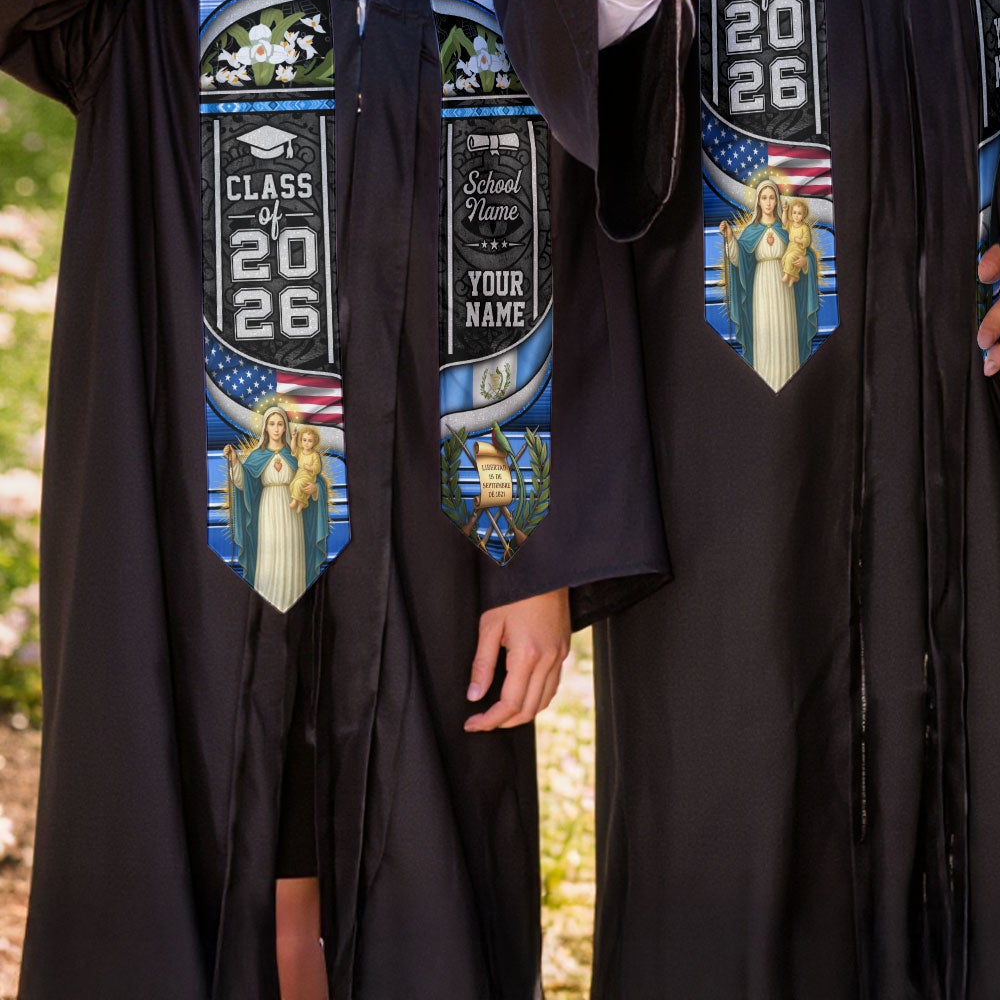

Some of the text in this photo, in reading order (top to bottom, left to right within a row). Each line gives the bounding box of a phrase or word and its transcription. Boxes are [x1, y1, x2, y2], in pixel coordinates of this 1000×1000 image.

[727, 56, 808, 116] 26
[226, 173, 313, 201] CLASS
[463, 169, 523, 195] School
[258, 200, 283, 241] of
[465, 197, 520, 222] Name
[229, 226, 318, 282] 20
[467, 270, 524, 297] YOUR
[232, 285, 320, 341] 26
[465, 301, 526, 328] NAME
